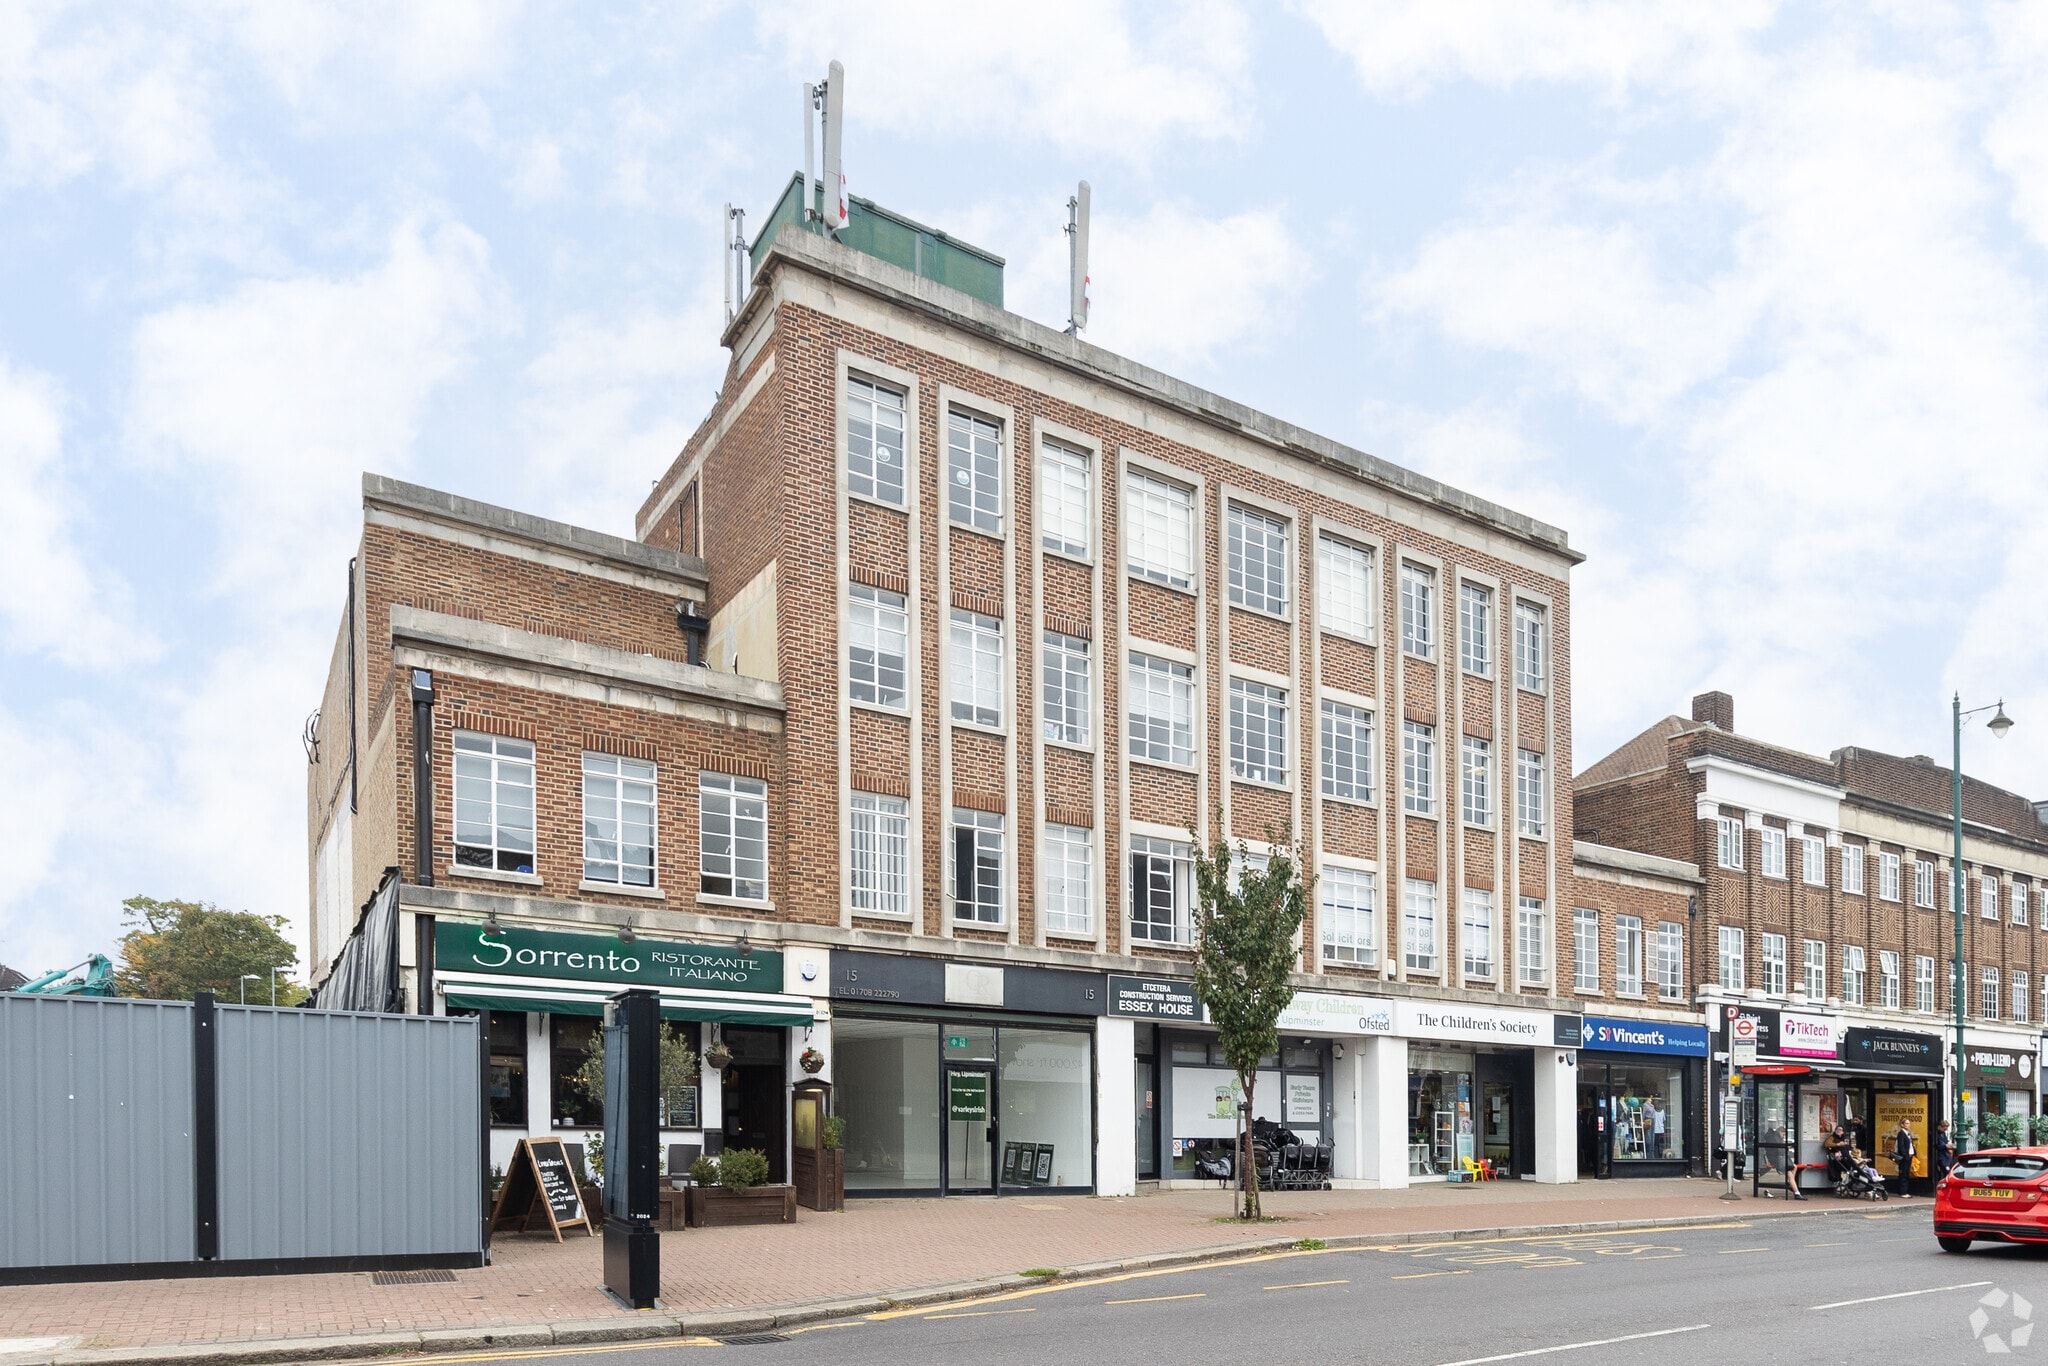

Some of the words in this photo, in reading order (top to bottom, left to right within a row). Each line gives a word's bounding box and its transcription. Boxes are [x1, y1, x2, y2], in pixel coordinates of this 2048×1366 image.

[472, 930, 641, 973] Sorrento
[651, 951, 761, 971] RISTORANTE
[669, 966, 748, 983] ITALIANO
[846, 969, 858, 982] 15
[850, 987, 873, 997] 01708
[874, 988, 900, 999] 222790
[1084, 988, 1095, 1000] 15
[1142, 983, 1171, 993] ETCETERA
[1119, 990, 1165, 1001] CONSTRUCTION
[1165, 993, 1193, 1004] SERVICES
[1118, 1000, 1154, 1013] ESSEX
[1158, 1003, 1194, 1016] HOUSE
[1316, 998, 1365, 1016] Children
[1727, 1007, 1737, 1018] D
[1281, 1015, 1324, 1027] Upminster
[1358, 1017, 1390, 1031] Ofsted
[1416, 1013, 1439, 1027] The
[1441, 1015, 1497, 1031] Children's
[1499, 1020, 1538, 1038] Society
[1612, 1027, 1665, 1046] Vincent's
[1796, 1022, 1829, 1037] TikTech
[1667, 1038, 1688, 1047] Helping
[1688, 1039, 1706, 1049] Locally
[1872, 1040, 1890, 1052] JACK
[1890, 1042, 1920, 1053] BUNNEYS
[1973, 1188, 1993, 1196] BU65
[1995, 1189, 2010, 1197] TUV
